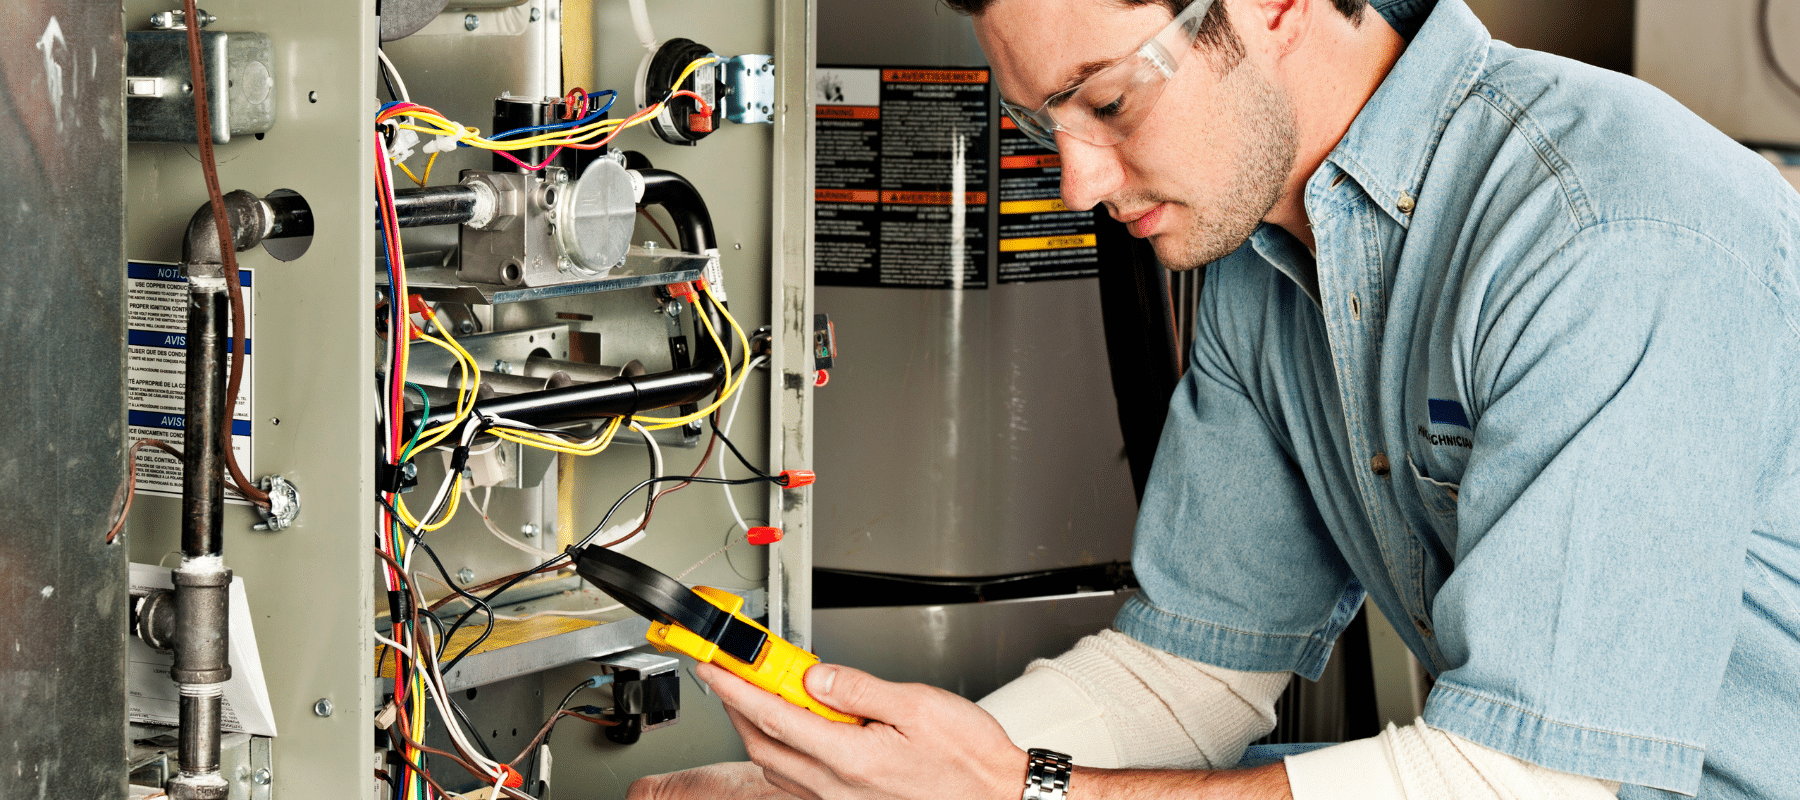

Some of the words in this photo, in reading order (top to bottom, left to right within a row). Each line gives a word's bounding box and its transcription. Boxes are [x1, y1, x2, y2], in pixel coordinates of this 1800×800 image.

[902, 72, 979, 80] AVERTISSEMENT
[900, 194, 978, 202] AVERTISSENT
[158, 268, 188, 278] NOT
[164, 335, 186, 346] AVIS
[138, 428, 168, 437] ÚNICAMENTE
